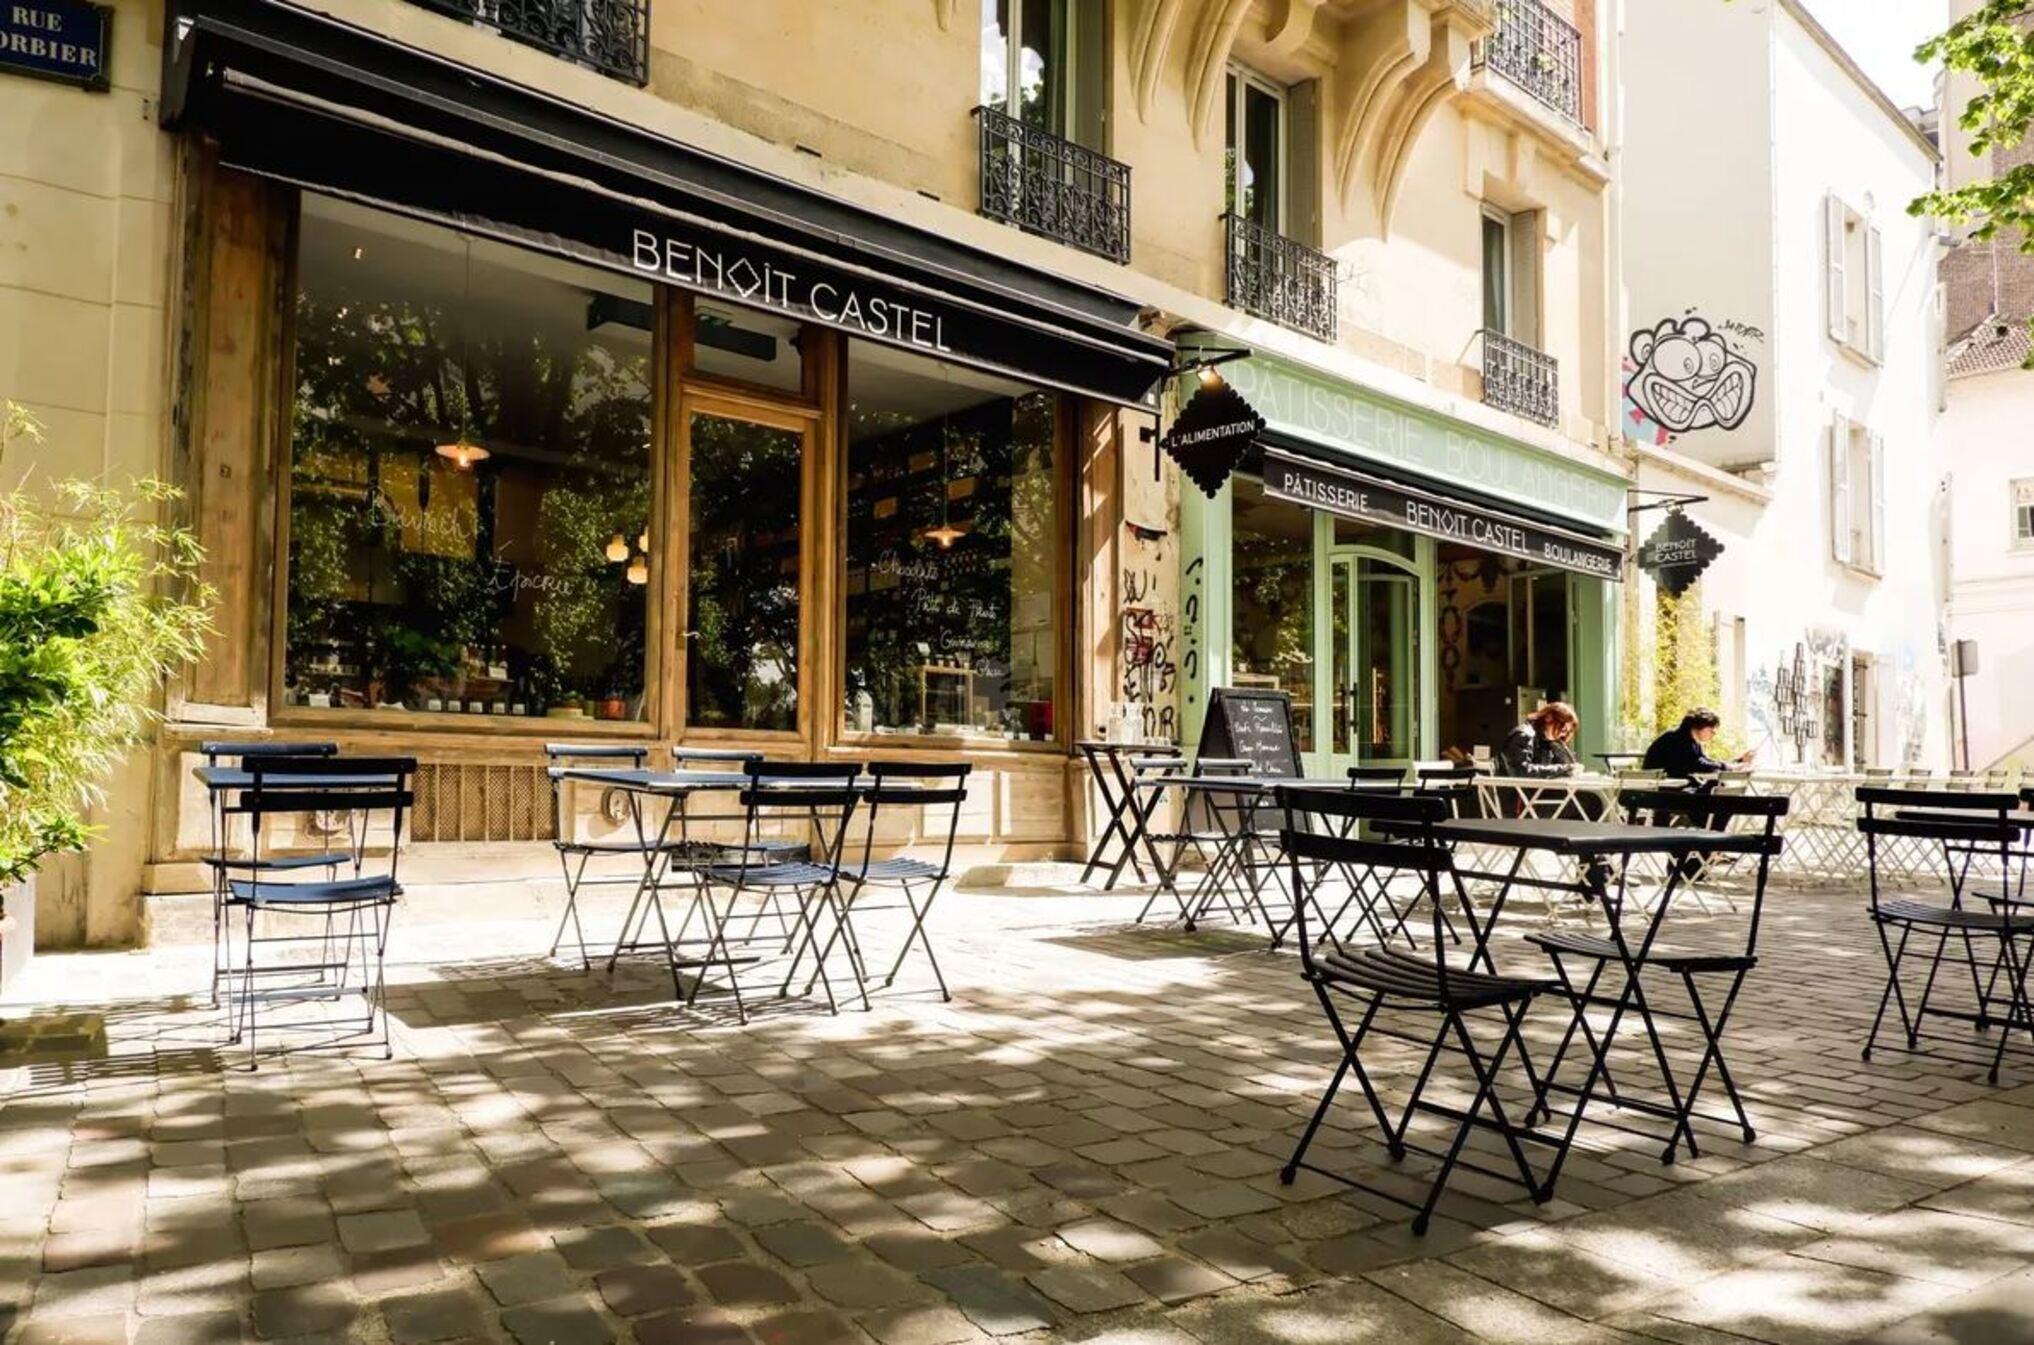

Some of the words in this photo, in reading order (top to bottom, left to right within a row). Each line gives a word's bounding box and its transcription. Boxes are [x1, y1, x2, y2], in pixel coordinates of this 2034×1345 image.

[12, 6, 62, 32] RUE
[810, 282, 951, 353] CASTEL
[1171, 420, 1255, 447] L'ALIMENTATION
[1284, 472, 1369, 513] PÂTISSERIE
[1471, 517, 1530, 554] CASTEL
[1544, 542, 1613, 574] BOULANGERIE
[1655, 549, 1697, 563] CASTEL
